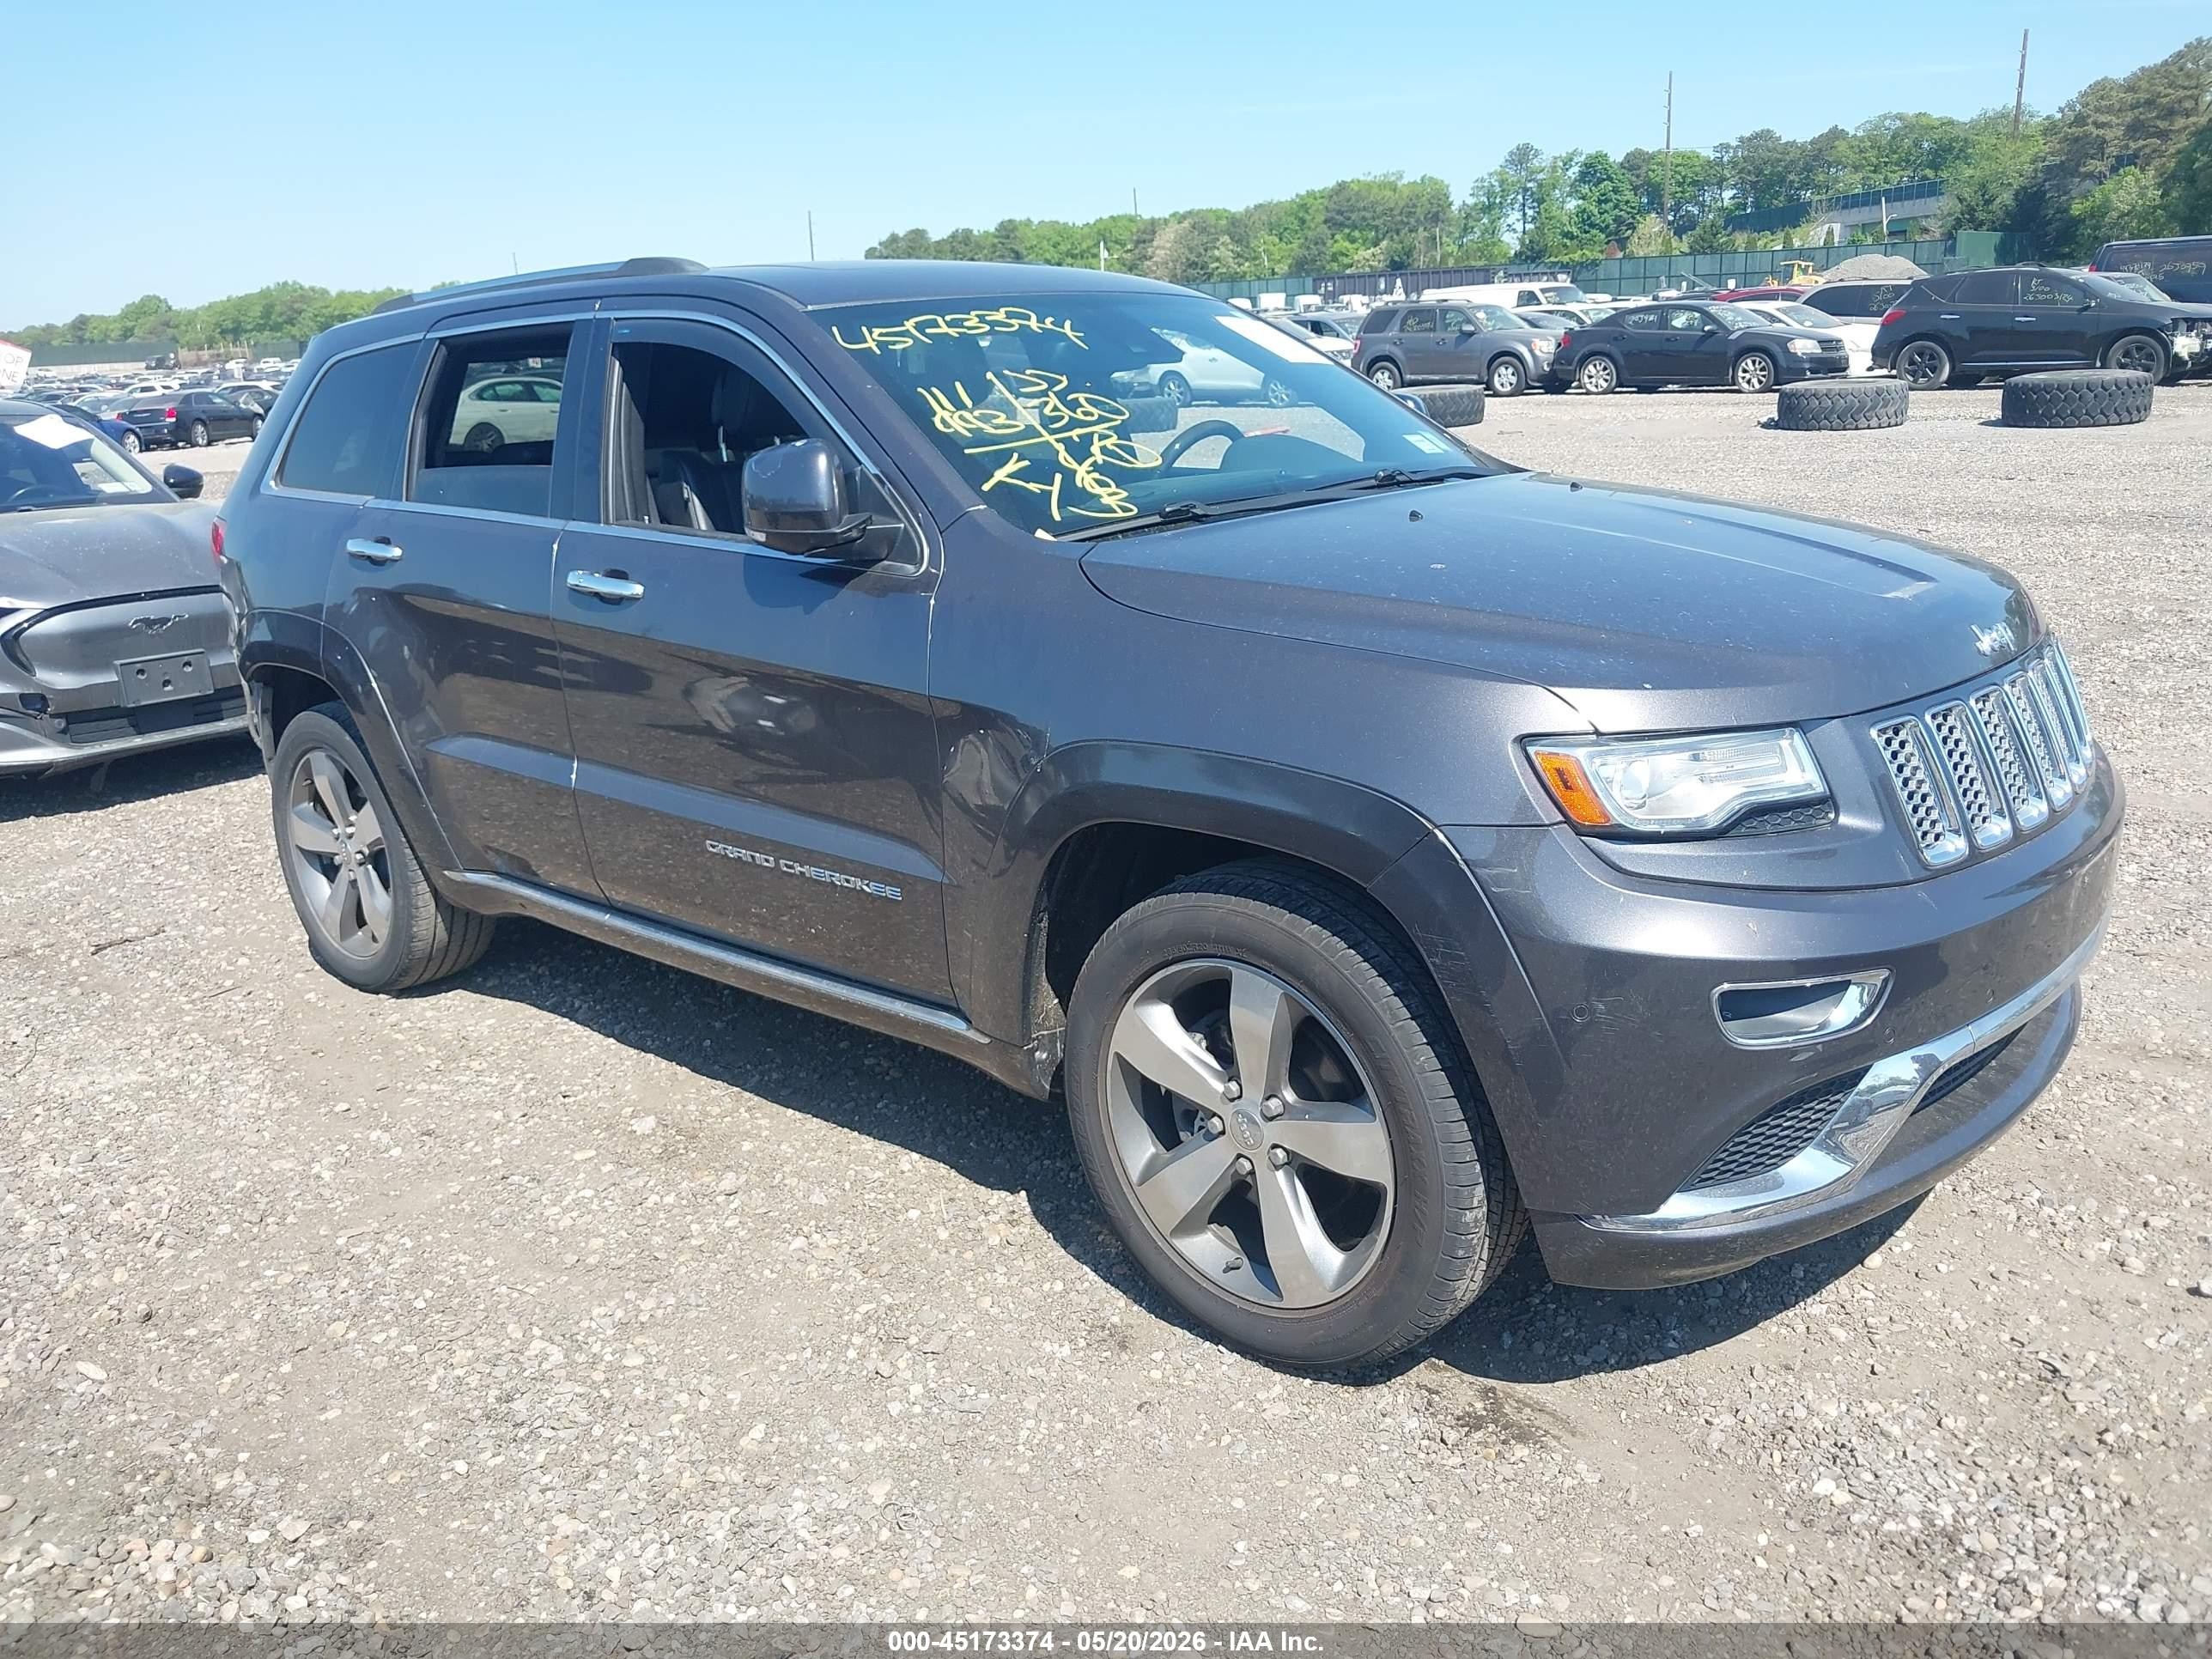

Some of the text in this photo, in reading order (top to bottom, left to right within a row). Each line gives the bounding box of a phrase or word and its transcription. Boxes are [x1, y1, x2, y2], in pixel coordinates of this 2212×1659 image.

[1, 368, 19, 384] NE
[706, 840, 902, 901] GRAND CHEROKEE
[1237, 1112, 1255, 1146] Jeep
